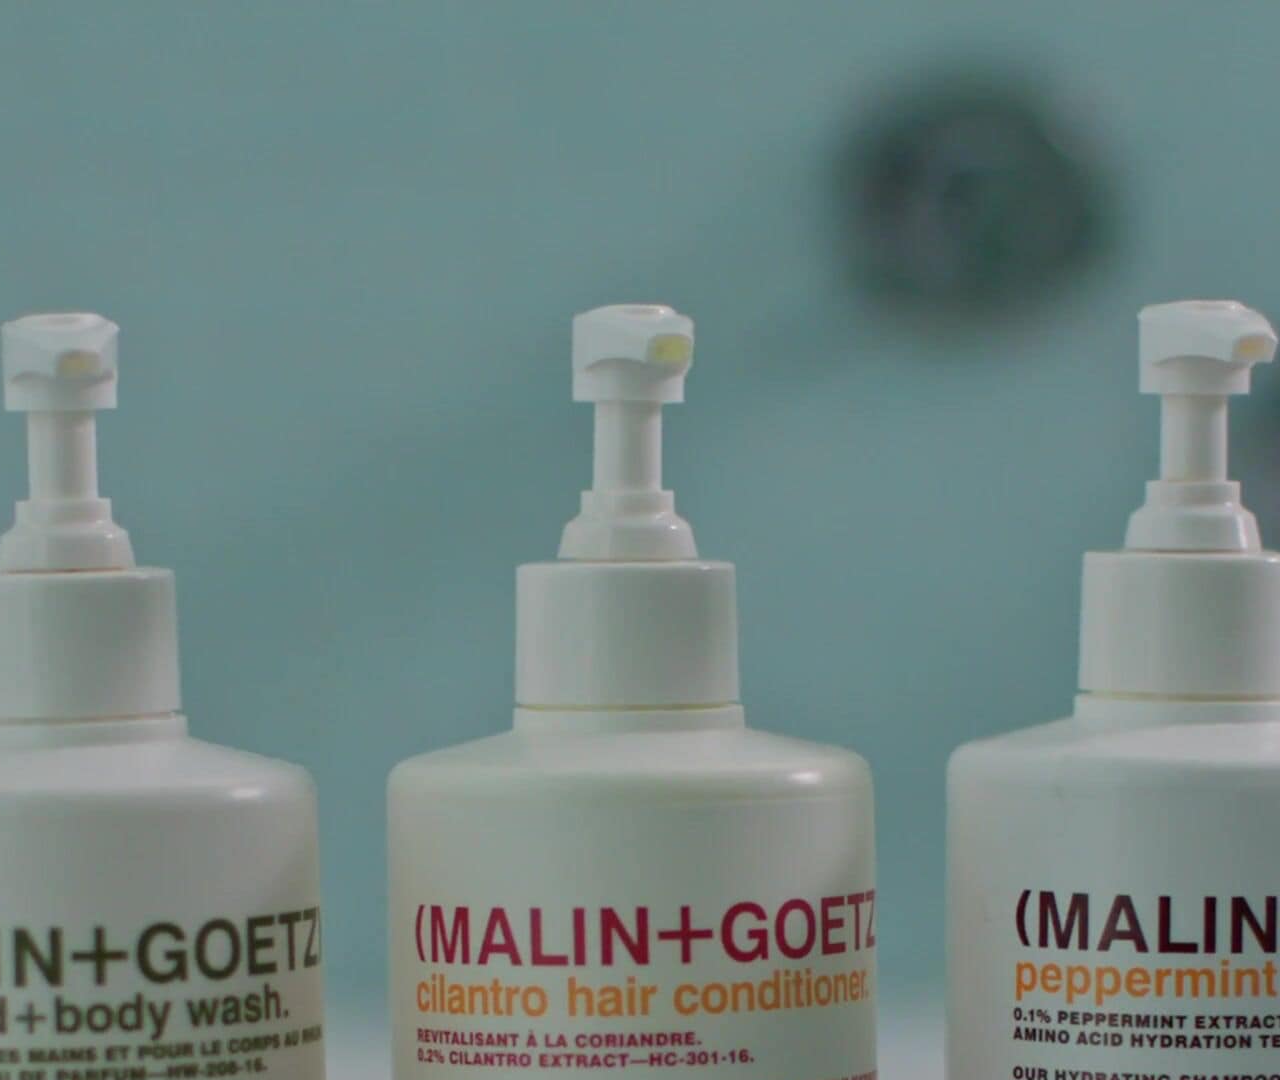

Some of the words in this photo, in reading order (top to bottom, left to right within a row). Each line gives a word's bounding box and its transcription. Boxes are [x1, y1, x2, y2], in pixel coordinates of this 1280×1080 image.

[417, 973, 548, 1017] cilantro
[567, 975, 657, 1017] hair
[673, 968, 870, 1017] conditioner.
[1015, 958, 1278, 1006] peppermint
[187, 985, 290, 1028] wash.
[1013, 1007, 1051, 1023] 0.1%
[1057, 1011, 1188, 1029] PEPPERMINT
[27, 1048, 97, 1064] MAINS
[104, 1046, 130, 1061] ET
[137, 1040, 194, 1060] POUR
[200, 1040, 221, 1057] LE
[226, 1033, 280, 1054] CORPS
[416, 1028, 519, 1048] REVITALISANT
[526, 1031, 537, 1047] À
[544, 1035, 568, 1048] LA
[574, 1031, 702, 1049] CORIANDRE.
[1012, 1026, 1070, 1044] AMINO
[1075, 1031, 1123, 1046] ACID
[1130, 1033, 1252, 1049] HYDRATION
[417, 1048, 445, 1064] 0.2%
[448, 1050, 531, 1067] CILANTRO
